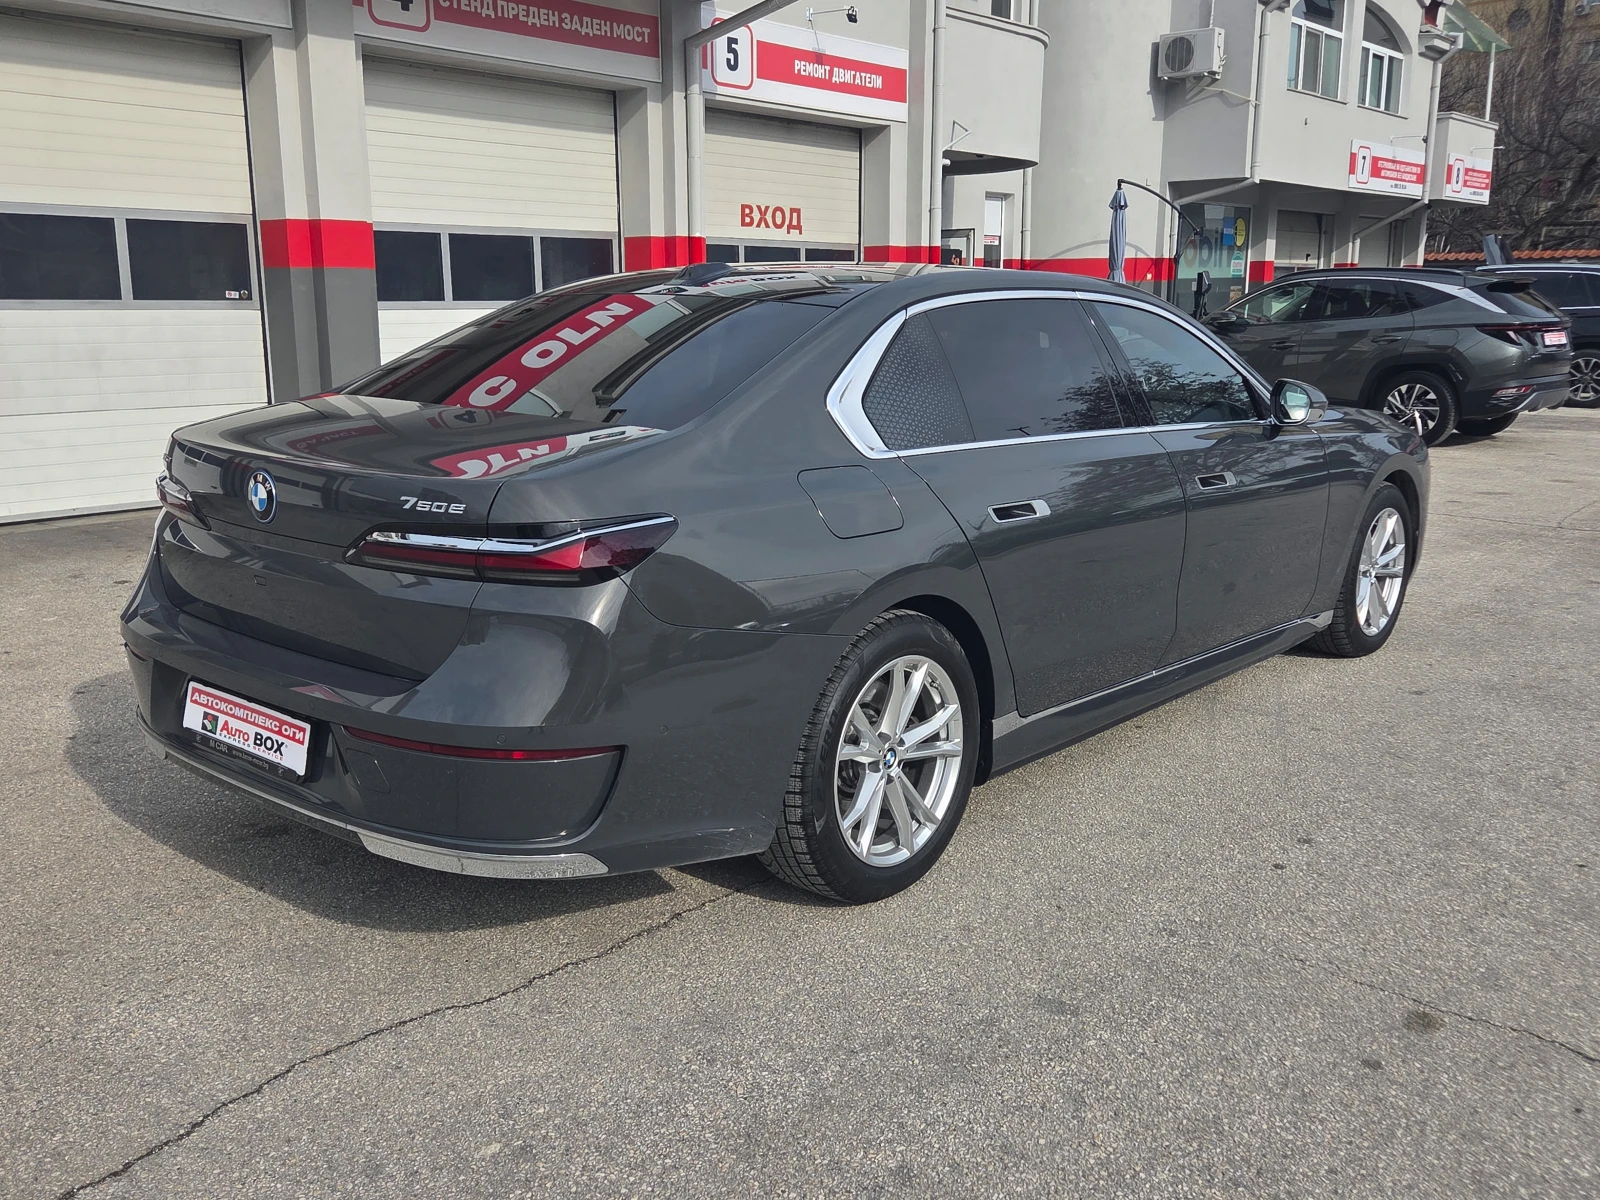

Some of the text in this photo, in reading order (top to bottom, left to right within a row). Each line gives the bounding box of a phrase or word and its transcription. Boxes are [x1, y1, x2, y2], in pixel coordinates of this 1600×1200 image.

[498, 0, 559, 27] ПРЕДЕН
[562, 12, 610, 36] ЗАДЕН
[613, 22, 650, 43] МОСТ
[726, 36, 739, 72] 5
[794, 60, 883, 89] РЕМОНТ ДВИГАТЕЛИ
[1361, 155, 1367, 175] 7
[740, 203, 803, 235] ВХОД
[249, 473, 272, 492] BMW
[192, 692, 304, 742] АВТОКОМПЛЕКС ОГИ
[215, 741, 228, 753] CAR
[219, 733, 284, 761] EXPRESS SERVICE
[253, 731, 285, 757] BOX
